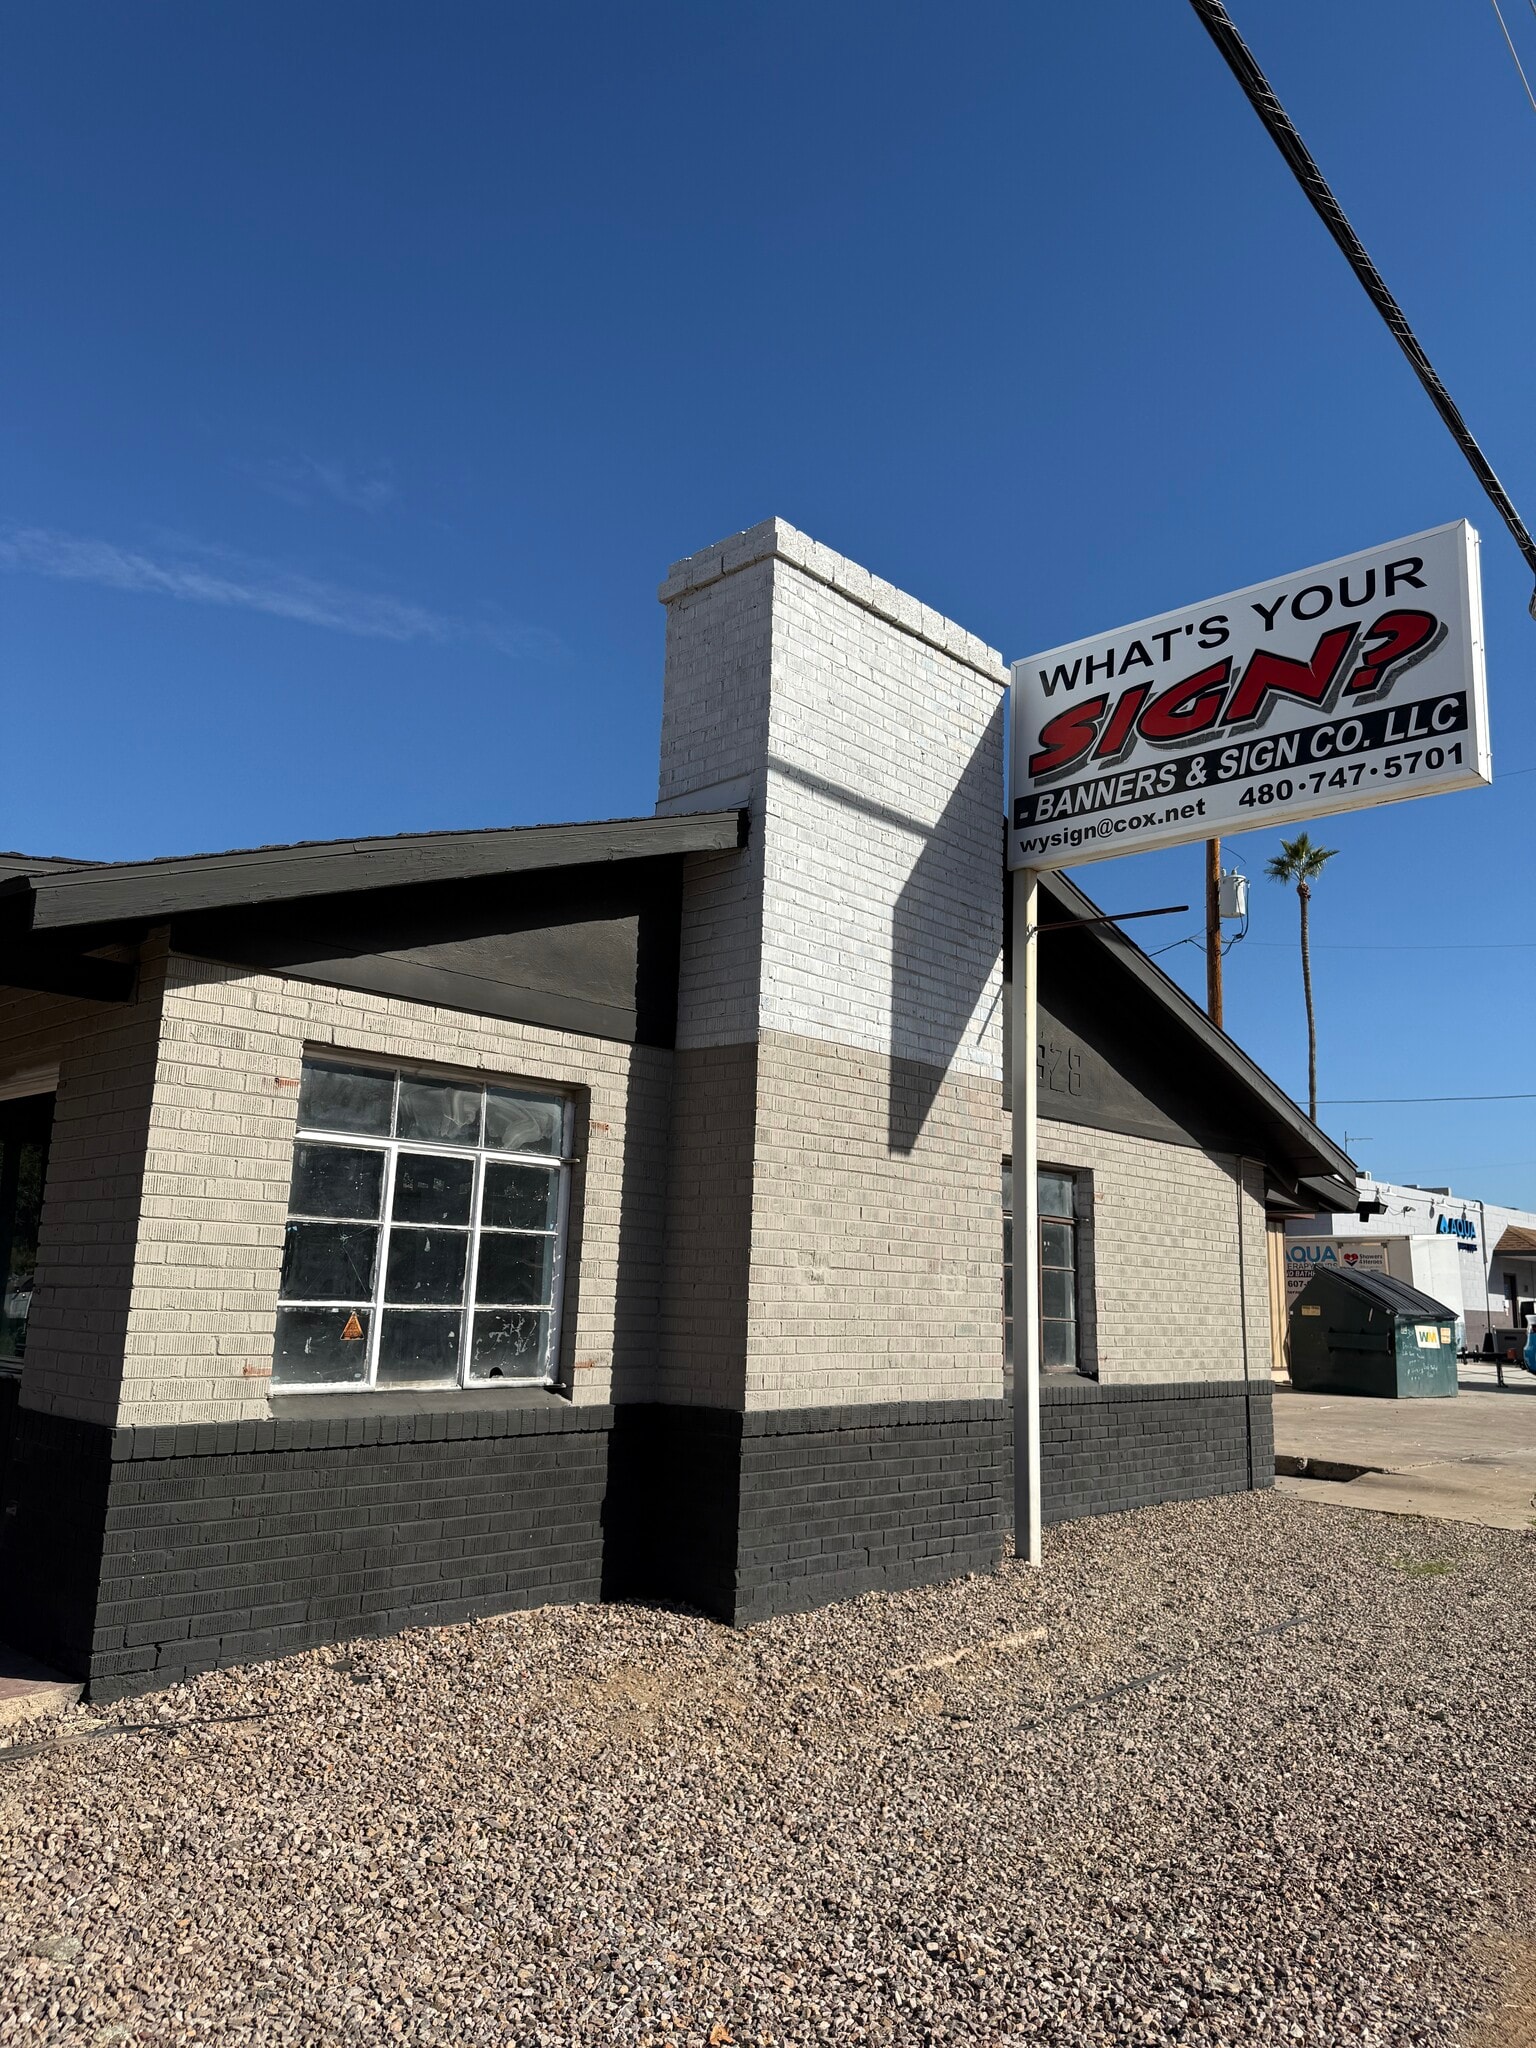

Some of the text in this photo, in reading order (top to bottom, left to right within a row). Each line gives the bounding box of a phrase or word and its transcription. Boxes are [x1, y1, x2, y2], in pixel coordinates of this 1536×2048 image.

[1039, 556, 1428, 698] WHAT'S YOUR
[1029, 609, 1438, 779] SIGN?
[1034, 763, 1178, 823] BANNERS
[1185, 756, 1207, 787] &
[1217, 733, 1300, 779] SIGN
[1310, 720, 1371, 758] CO.
[1383, 697, 1460, 743] LLC
[1019, 797, 1206, 853] wysign@cox.net
[1450, 1218, 1476, 1238] AQUA
[1419, 1331, 1437, 1343] WM
